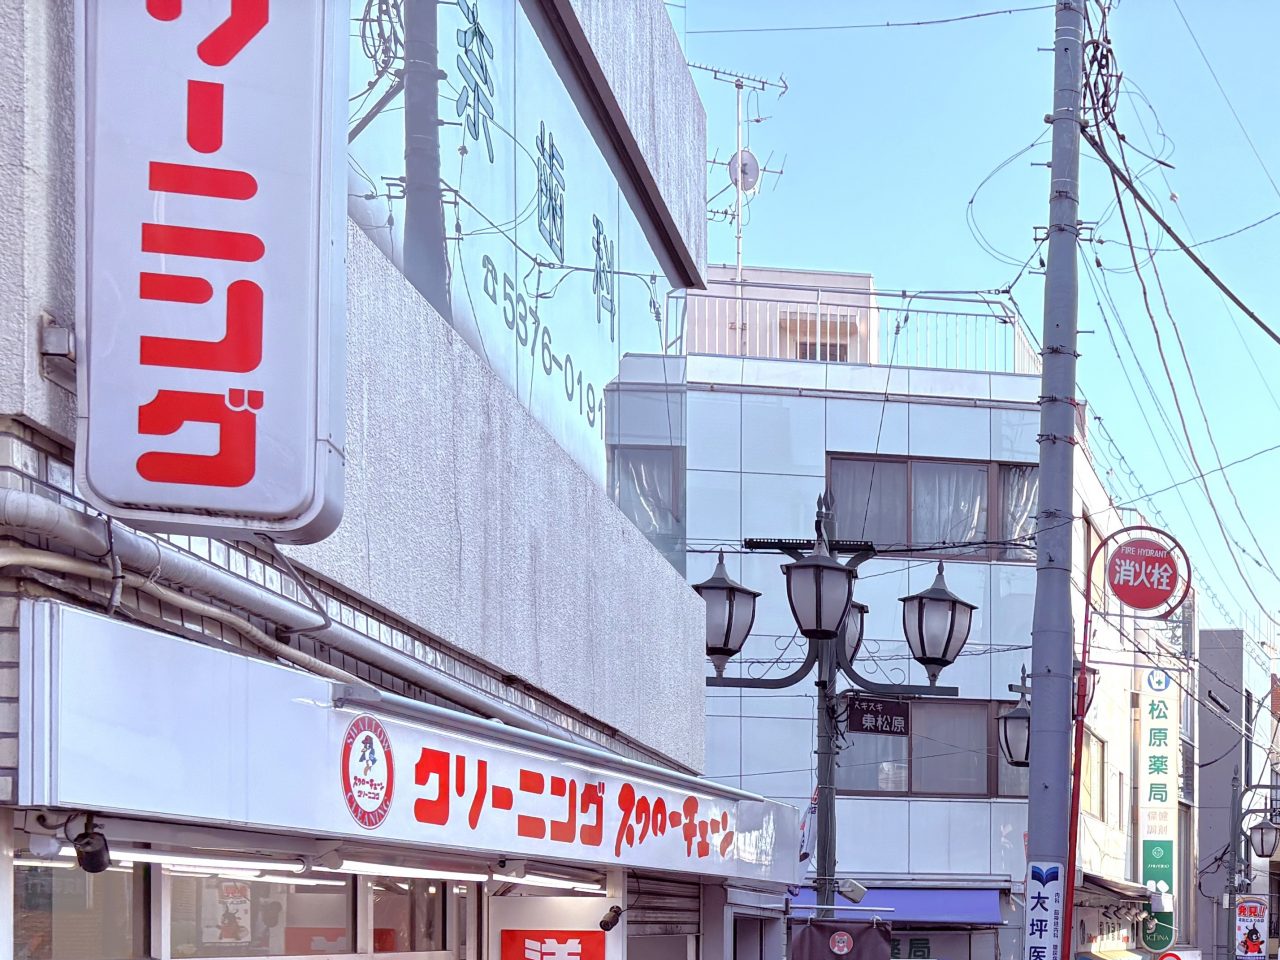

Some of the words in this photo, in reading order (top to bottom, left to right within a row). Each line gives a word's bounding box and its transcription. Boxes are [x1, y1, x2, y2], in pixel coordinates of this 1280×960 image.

[1121, 546, 1136, 555] FIRE
[1137, 548, 1168, 558] HYDRANT
[1113, 558, 1173, 591] 消火栓
[862, 713, 905, 733] 東松原
[1147, 699, 1169, 803] 松原薬局
[414, 747, 605, 847] クリーニング
[615, 782, 734, 858] スワローチェーン
